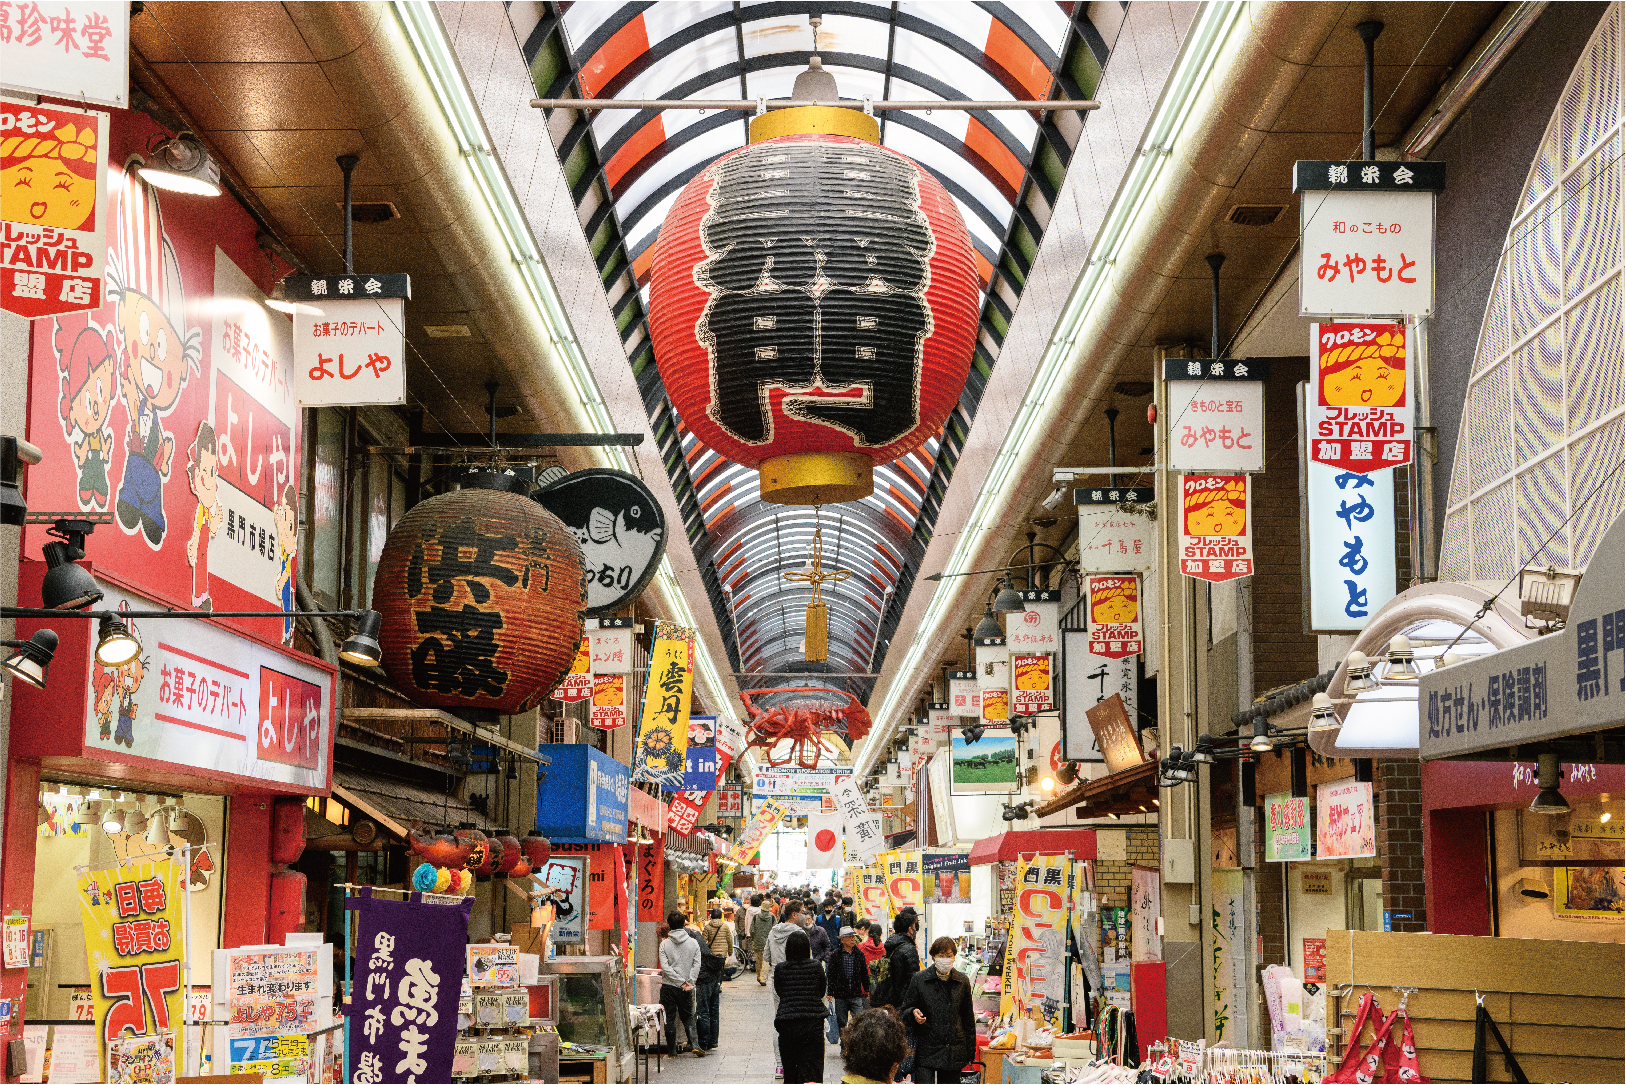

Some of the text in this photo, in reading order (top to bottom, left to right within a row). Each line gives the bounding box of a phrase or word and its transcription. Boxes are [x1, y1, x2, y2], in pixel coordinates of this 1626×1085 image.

[1333, 221, 1401, 234] 和のこもの
[1317, 253, 1416, 283] みやもと
[313, 320, 384, 337] お菓子のデパート
[1321, 328, 1376, 348] クロモン
[309, 353, 391, 380] よしや
[1191, 400, 1243, 412] きものと宝石
[1326, 407, 1395, 421] フレッシュ
[1318, 421, 1405, 438] STAMP
[1181, 425, 1252, 449] みやもと
[219, 392, 287, 504] よしや
[1318, 441, 1405, 460] 加盟店
[1185, 478, 1225, 493] クロモン
[226, 509, 275, 561] 黒門市場店
[1190, 537, 1239, 546] フレッシュ
[1185, 547, 1246, 557] STAMP
[1186, 560, 1247, 572] 加盟店
[1091, 578, 1122, 590] クロモン
[1092, 631, 1138, 640] STAMP
[1093, 642, 1138, 652] 加盟店
[1016, 659, 1037, 667] クロモン
[593, 677, 614, 685] クロモン
[160, 663, 246, 724] お菓子のデパート
[554, 689, 590, 697] 加盟店
[652, 661, 687, 725] 雲丹
[261, 681, 317, 758] よしや
[593, 718, 625, 726] 加盟店
[237, 981, 311, 995] 生まれ変わります
